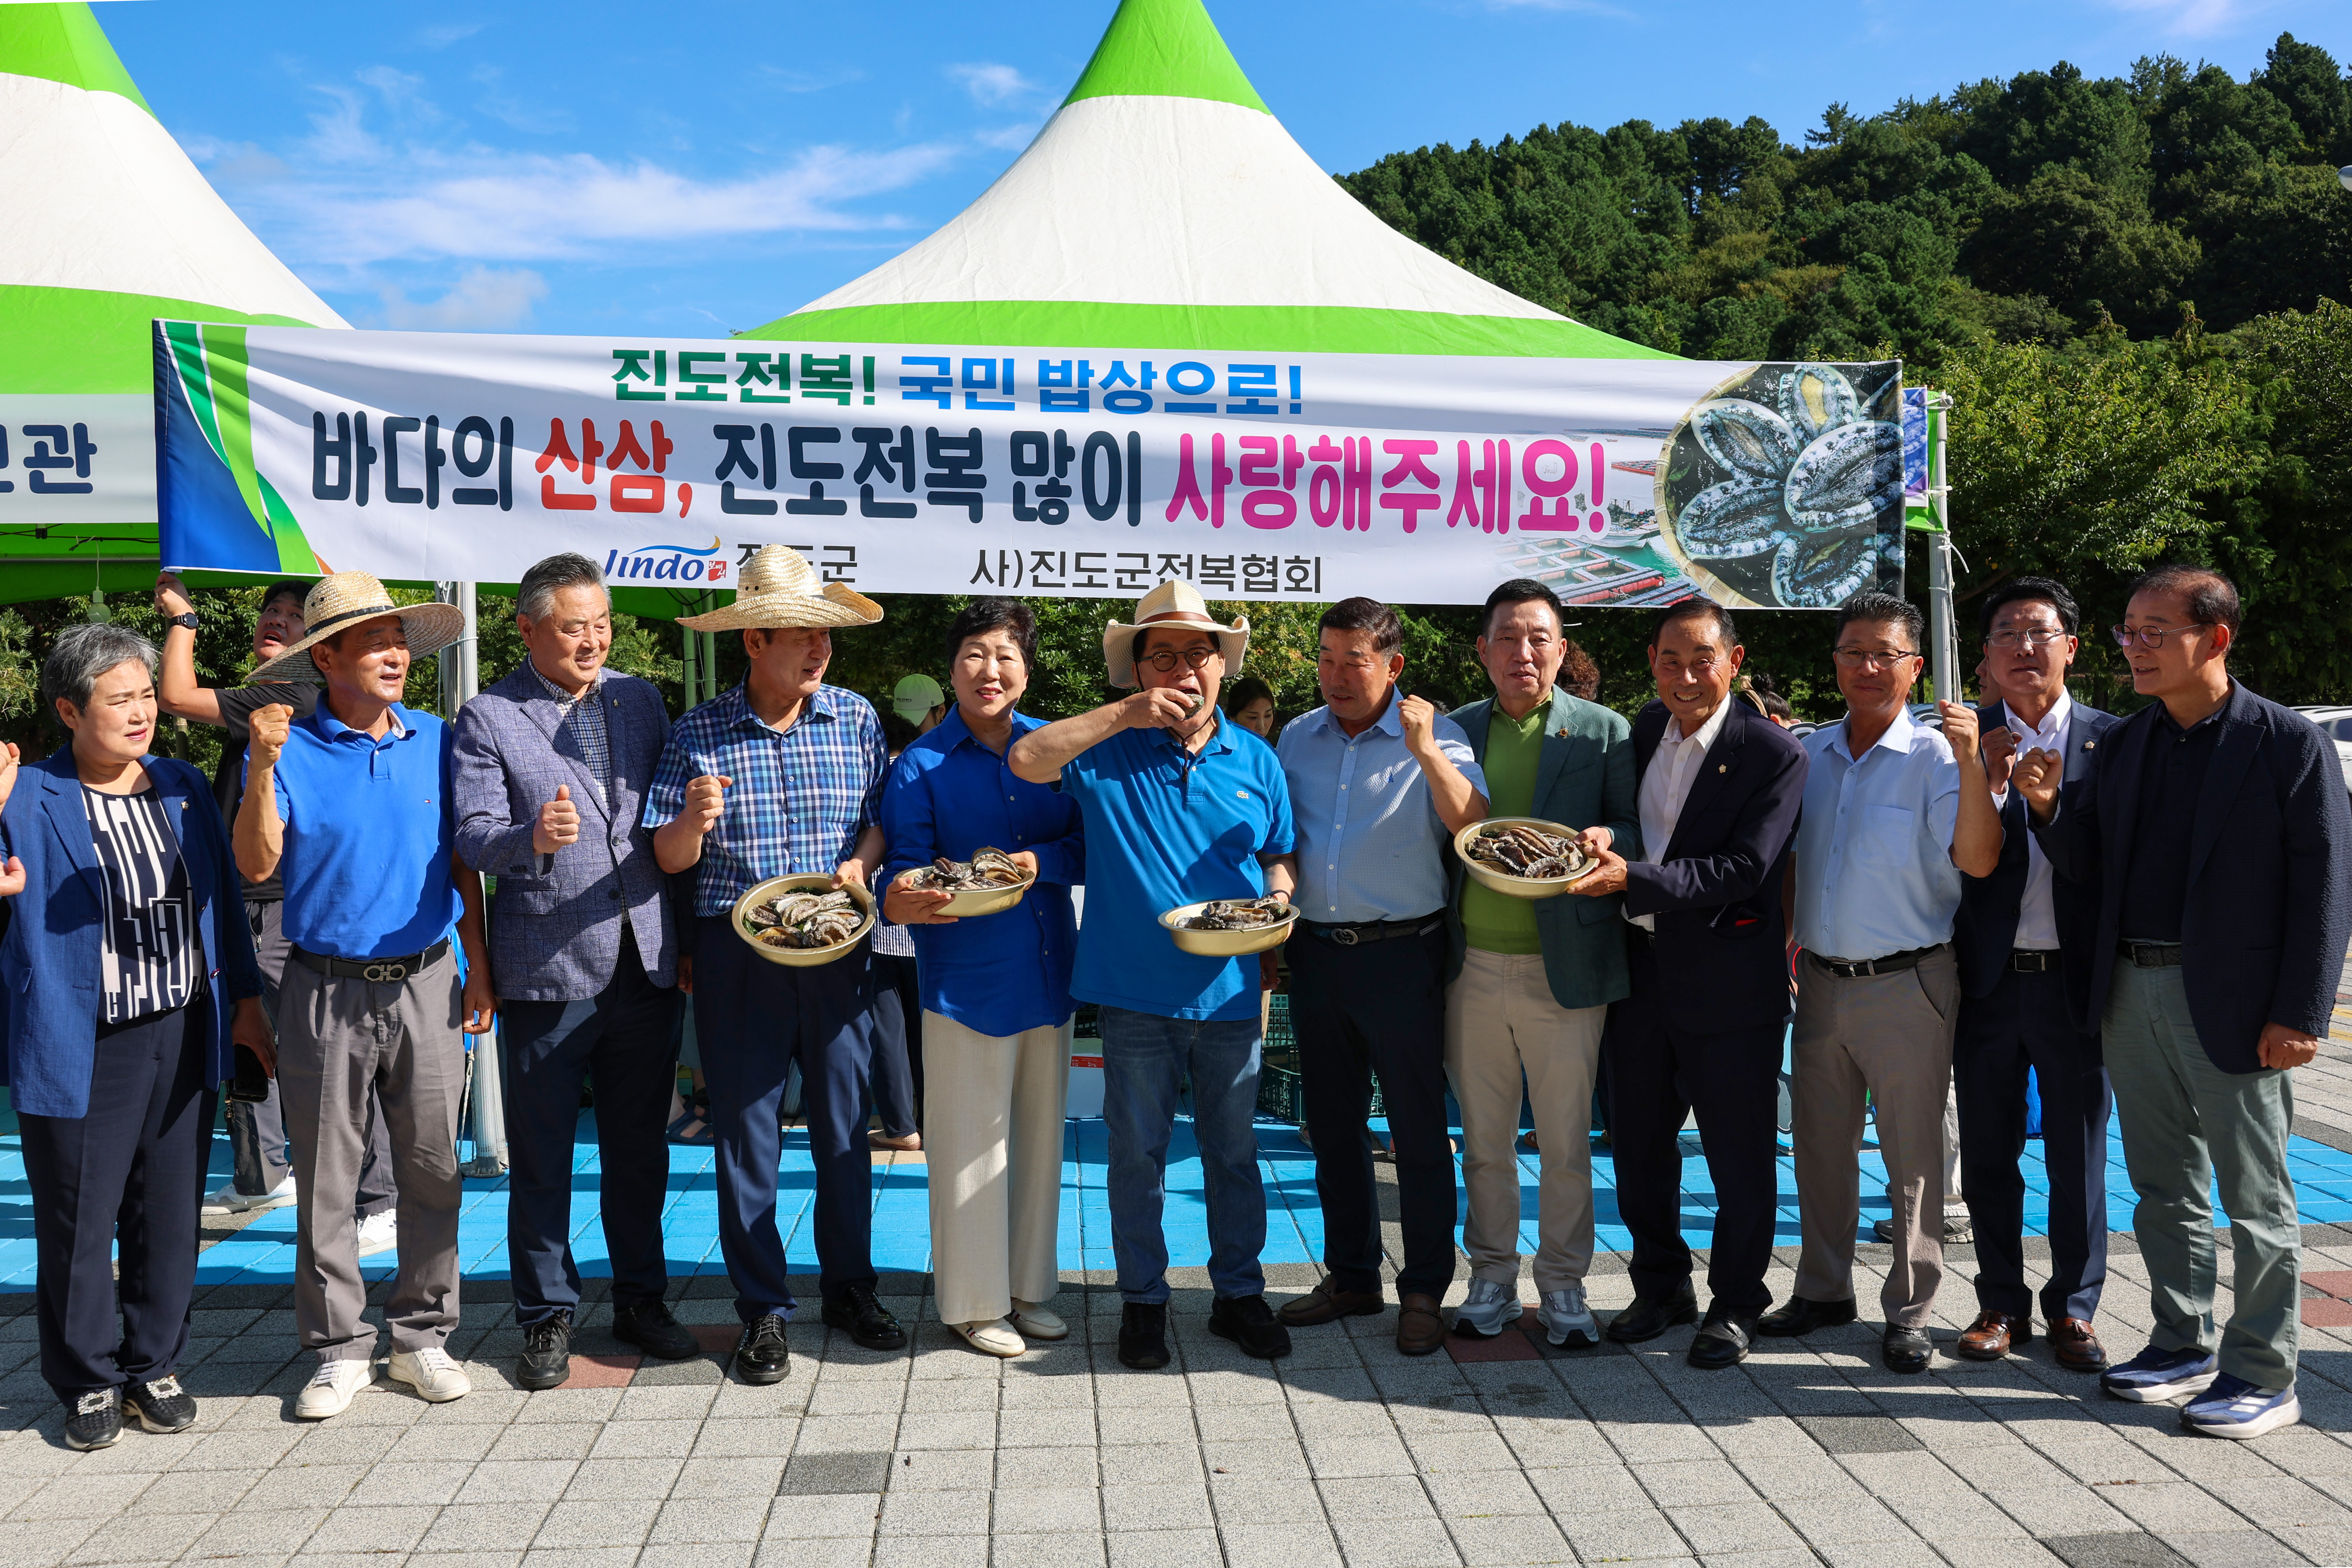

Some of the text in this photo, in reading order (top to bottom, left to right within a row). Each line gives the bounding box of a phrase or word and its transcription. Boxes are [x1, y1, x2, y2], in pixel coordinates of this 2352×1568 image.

[612, 349, 1301, 415] 진도전복! 국민 밥상으로!
[0, 422, 98, 494] 관
[312, 410, 1604, 535] 바다의 산삼, 진도전복 많이 사랑해주세요!
[969, 549, 1321, 593] 사)진도군전복협회
